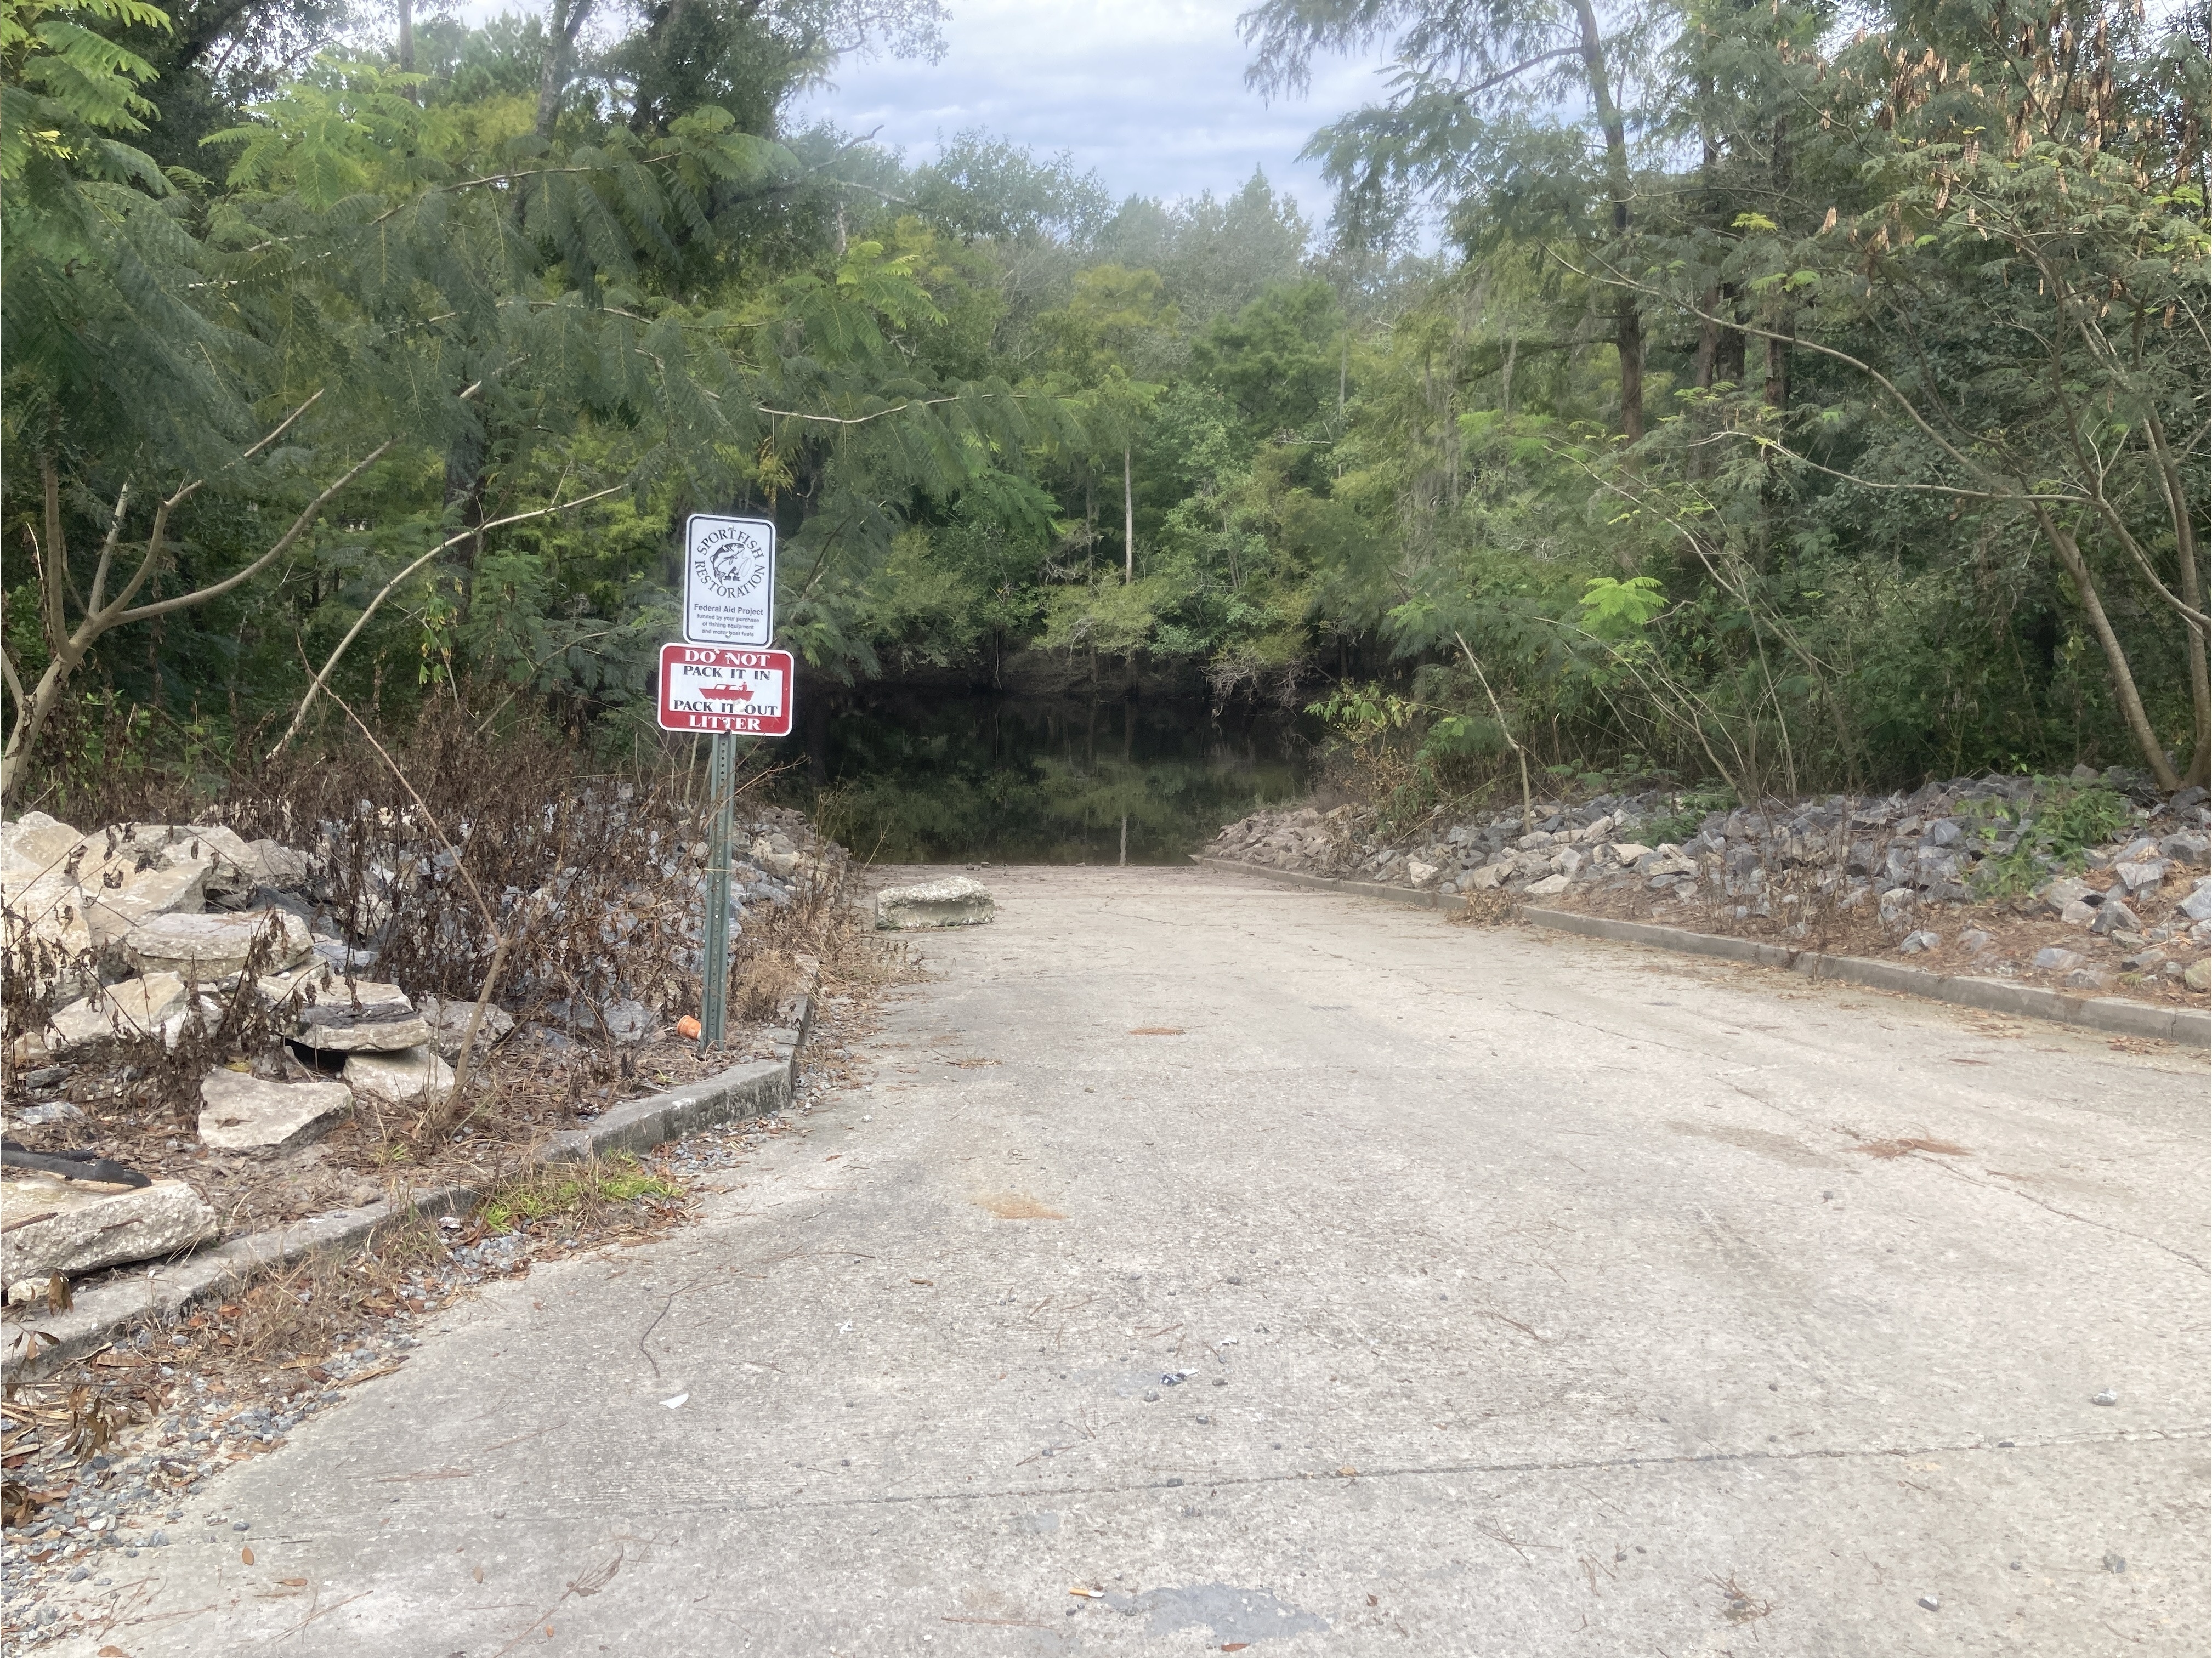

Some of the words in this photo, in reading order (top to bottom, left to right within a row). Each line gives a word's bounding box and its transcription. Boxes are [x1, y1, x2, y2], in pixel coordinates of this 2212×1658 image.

[695, 561, 765, 598] RESTORATION
[685, 650, 716, 663] DO
[725, 653, 770, 667] NOT
[683, 666, 722, 678] PACK
[731, 669, 746, 679] IT
[754, 670, 770, 680] IN
[674, 700, 713, 712] PACK
[722, 703, 734, 713] IT
[745, 705, 778, 716] OUT
[689, 714, 761, 730] LITTER
